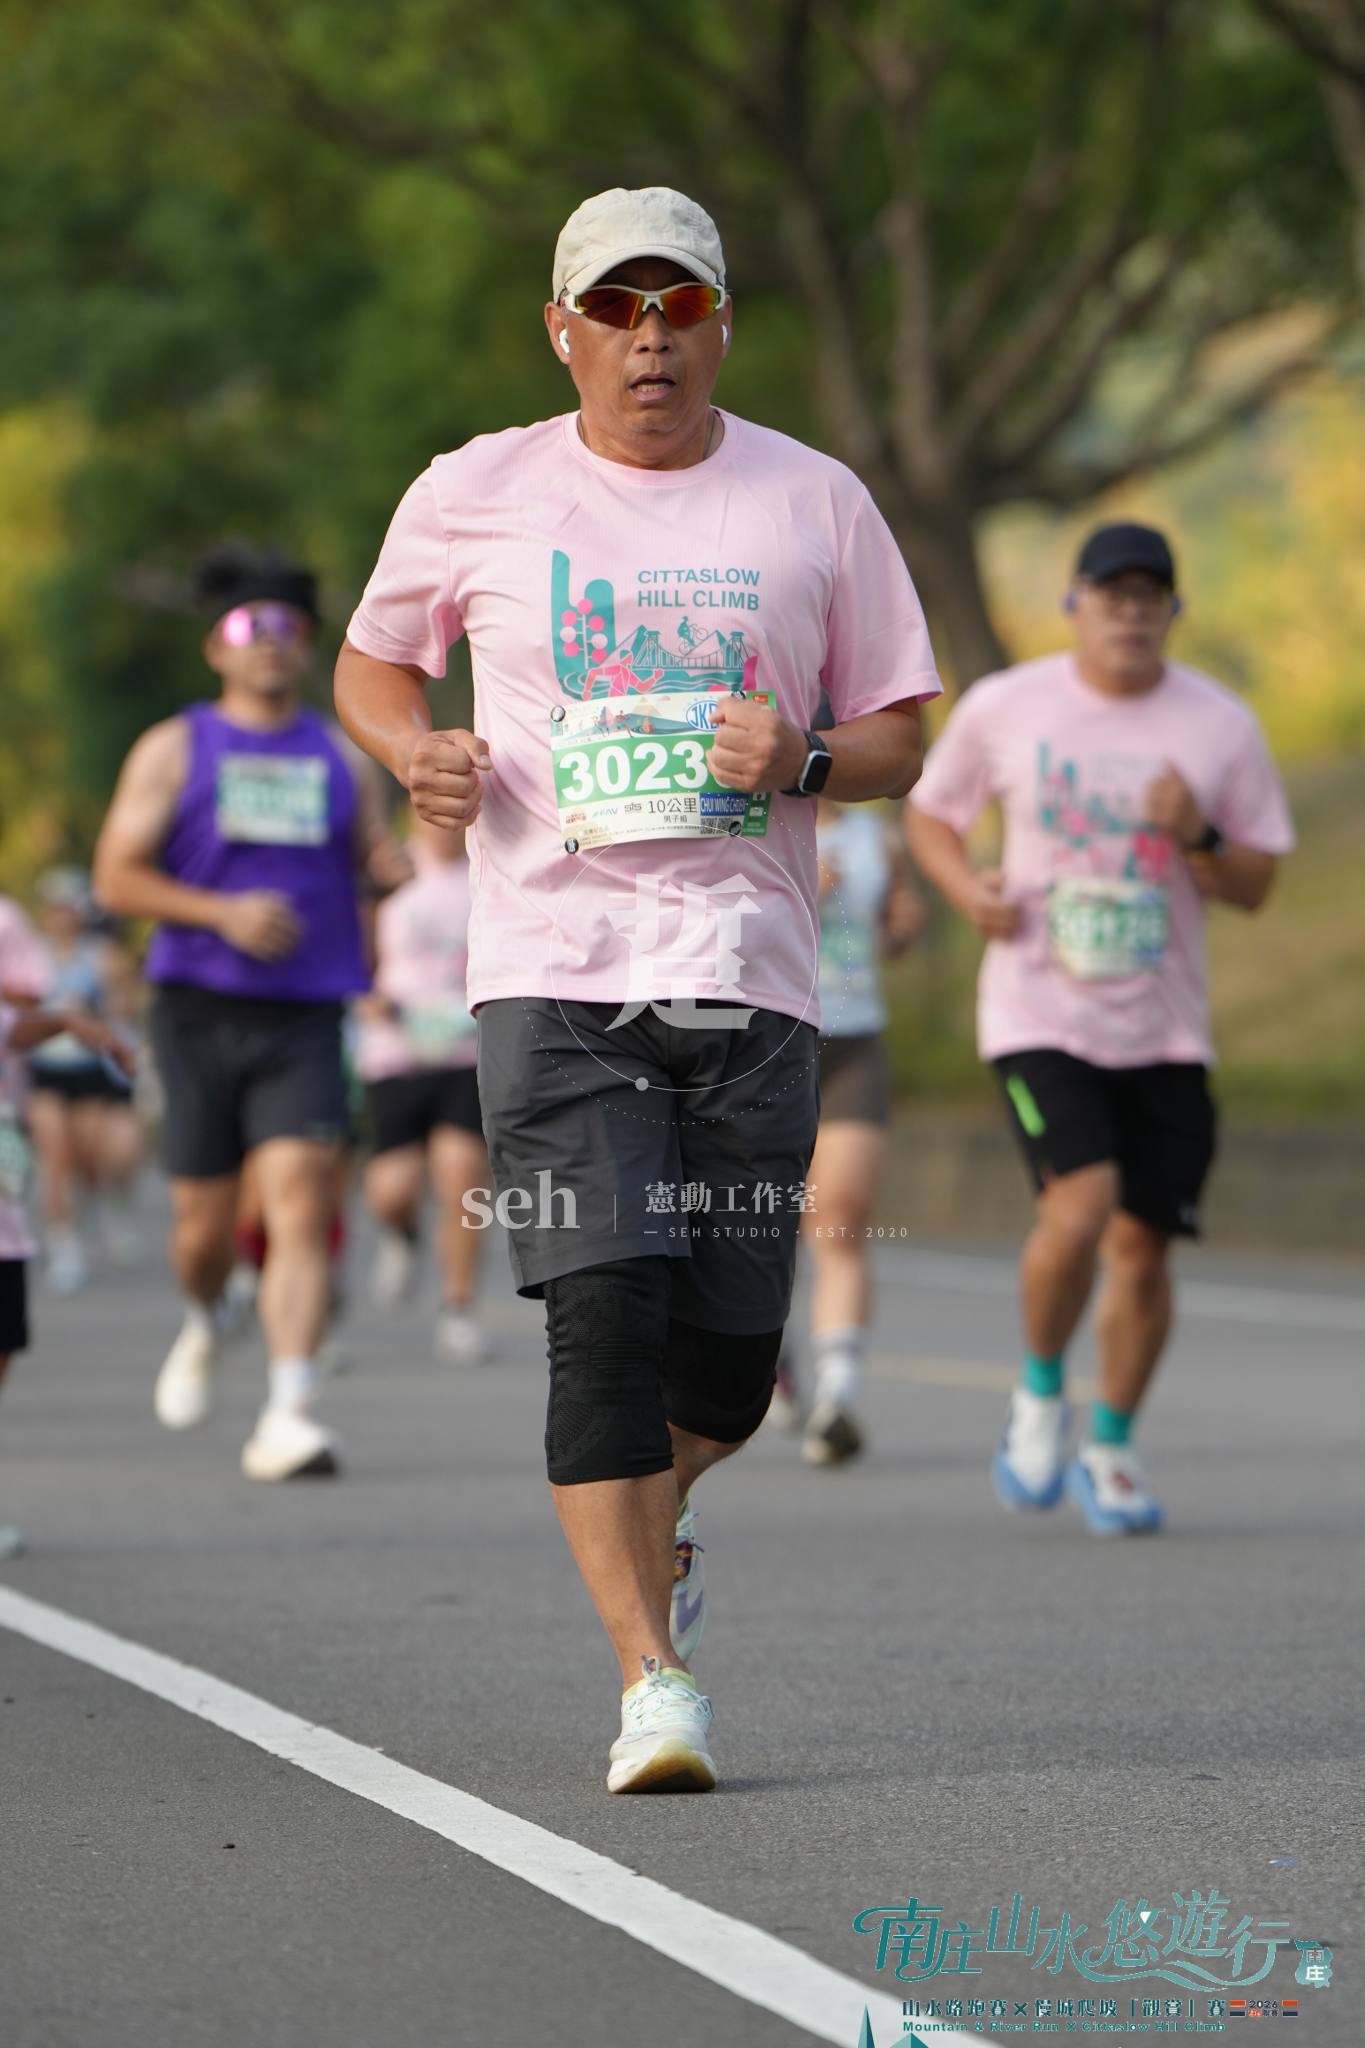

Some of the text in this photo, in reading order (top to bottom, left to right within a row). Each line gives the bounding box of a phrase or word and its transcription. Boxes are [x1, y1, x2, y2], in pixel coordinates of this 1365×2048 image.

[637, 567, 760, 587] CITTASLOW
[637, 589, 760, 611] HILL CLIMB
[559, 740, 733, 801] 3023
[648, 797, 698, 814] 10公里
